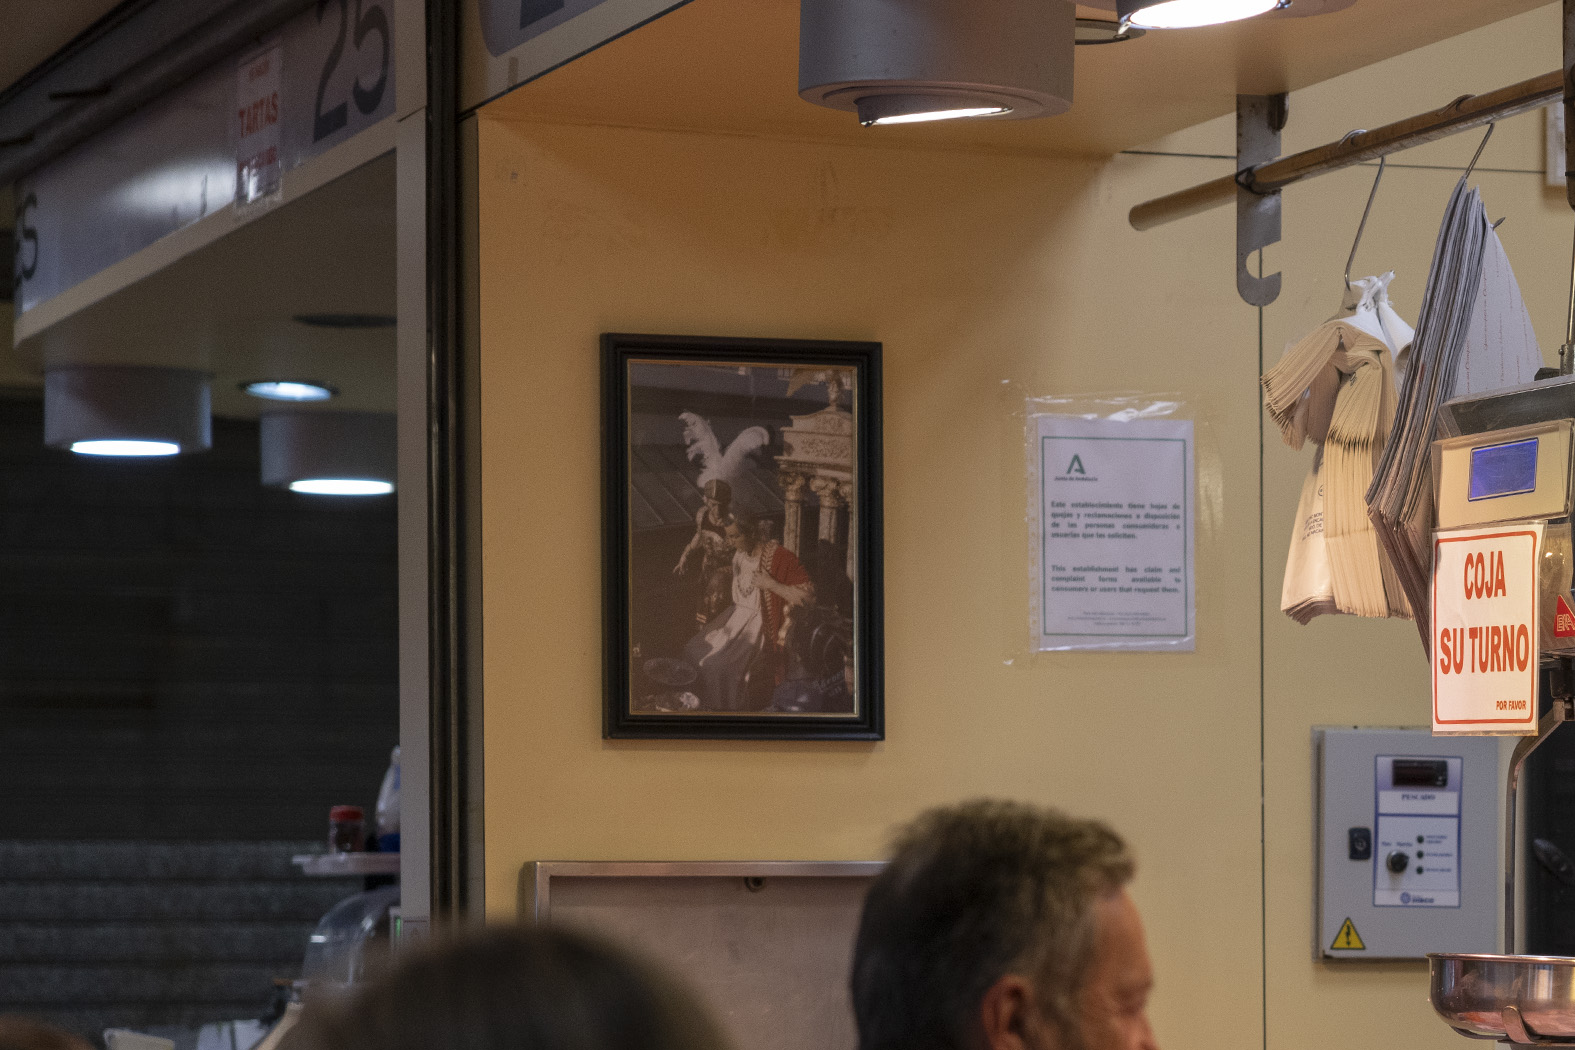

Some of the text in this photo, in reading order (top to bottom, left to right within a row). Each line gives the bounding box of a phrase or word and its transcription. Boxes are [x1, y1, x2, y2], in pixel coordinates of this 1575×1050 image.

[238, 91, 279, 138] TARTAS
[1051, 564, 1066, 572] This
[1464, 550, 1507, 600] COJA
[1440, 623, 1530, 675] SU TURNO
[1495, 699, 1527, 711] POR FAVOR
